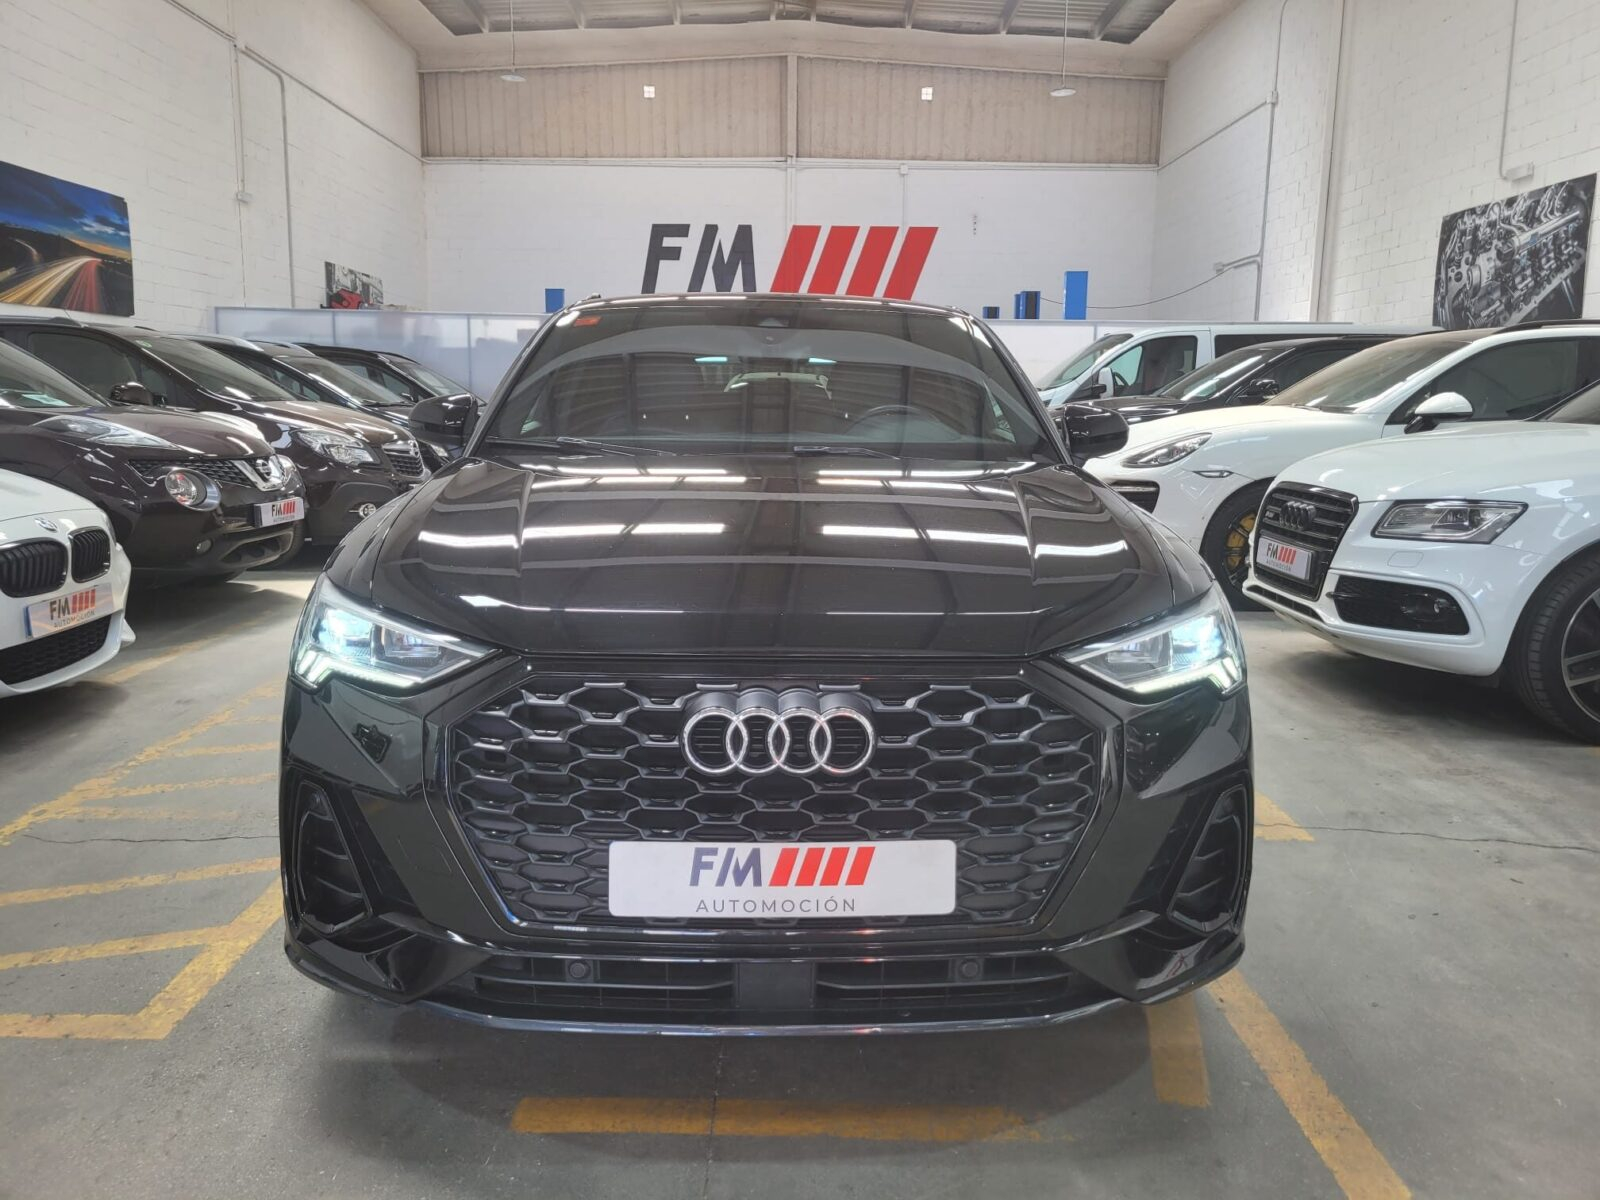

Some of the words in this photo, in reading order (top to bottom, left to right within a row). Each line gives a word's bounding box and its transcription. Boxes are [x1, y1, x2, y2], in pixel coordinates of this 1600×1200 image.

[641, 223, 757, 294] FM
[272, 504, 283, 517] FM
[1266, 543, 1279, 559] FM
[49, 597, 70, 620] FM
[689, 847, 762, 887] FM
[696, 895, 856, 913] AUTOMOCIÓN
